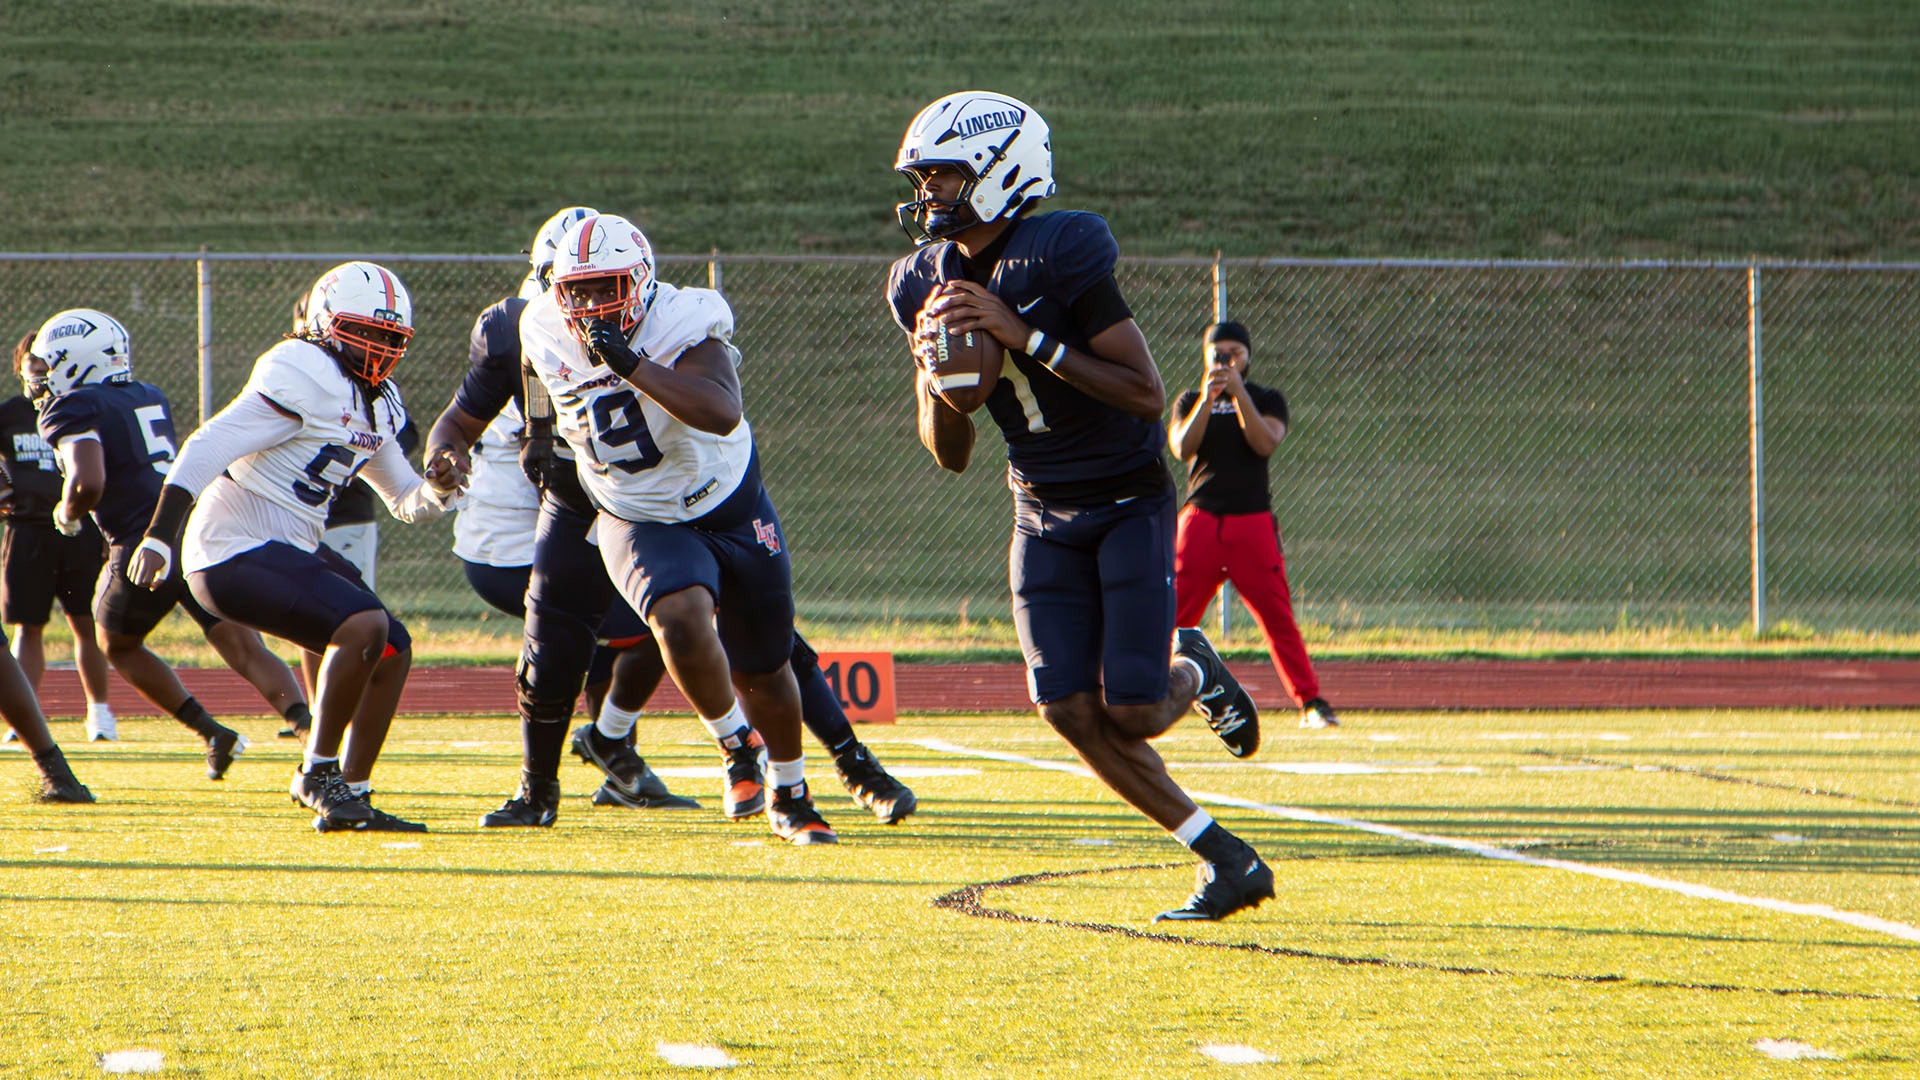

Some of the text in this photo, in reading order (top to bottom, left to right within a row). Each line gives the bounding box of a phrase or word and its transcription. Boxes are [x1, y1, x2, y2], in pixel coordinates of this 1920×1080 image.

[958, 110, 1020, 138] LINCOLN
[47, 323, 87, 341] INCOLN
[134, 404, 177, 476] 5
[823, 661, 880, 711] 10
